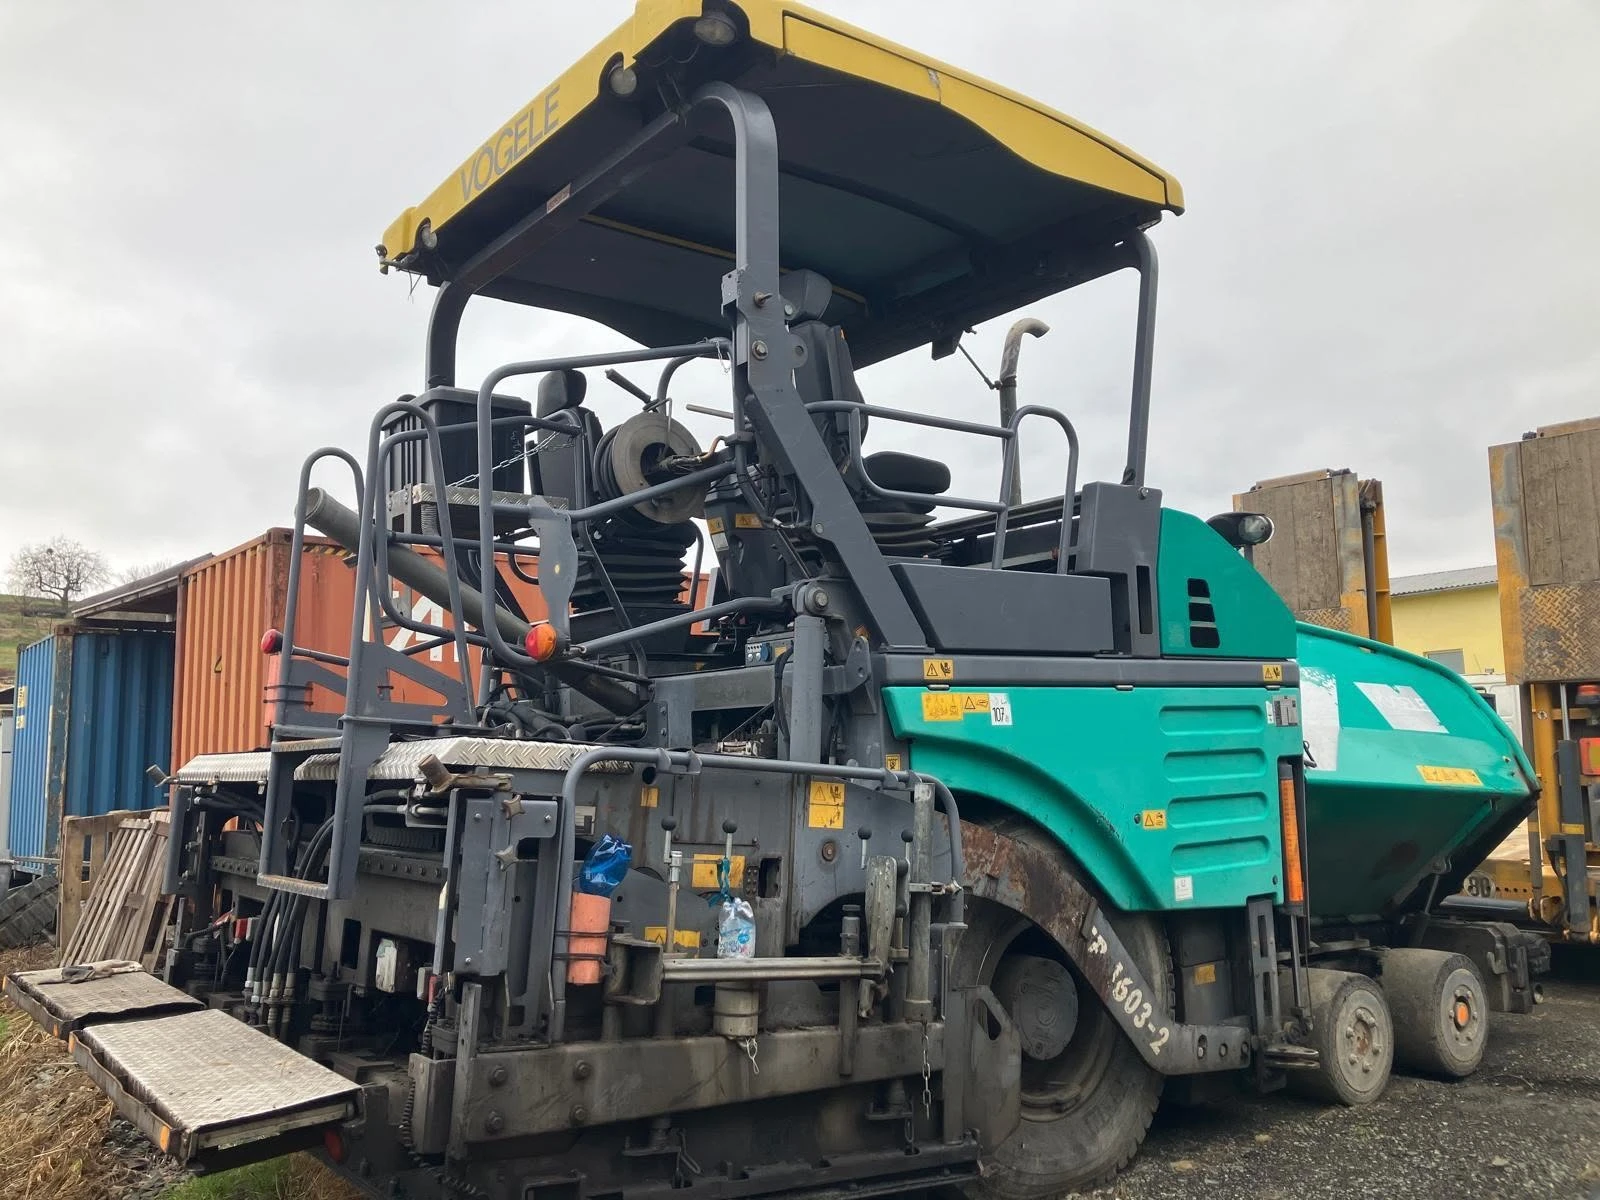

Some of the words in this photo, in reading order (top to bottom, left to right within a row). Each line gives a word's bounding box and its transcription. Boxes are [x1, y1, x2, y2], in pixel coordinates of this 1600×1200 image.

[992, 707, 1004, 722] 107
[1467, 876, 1491, 897] 80
[1111, 961, 1169, 1055] 1603-2
